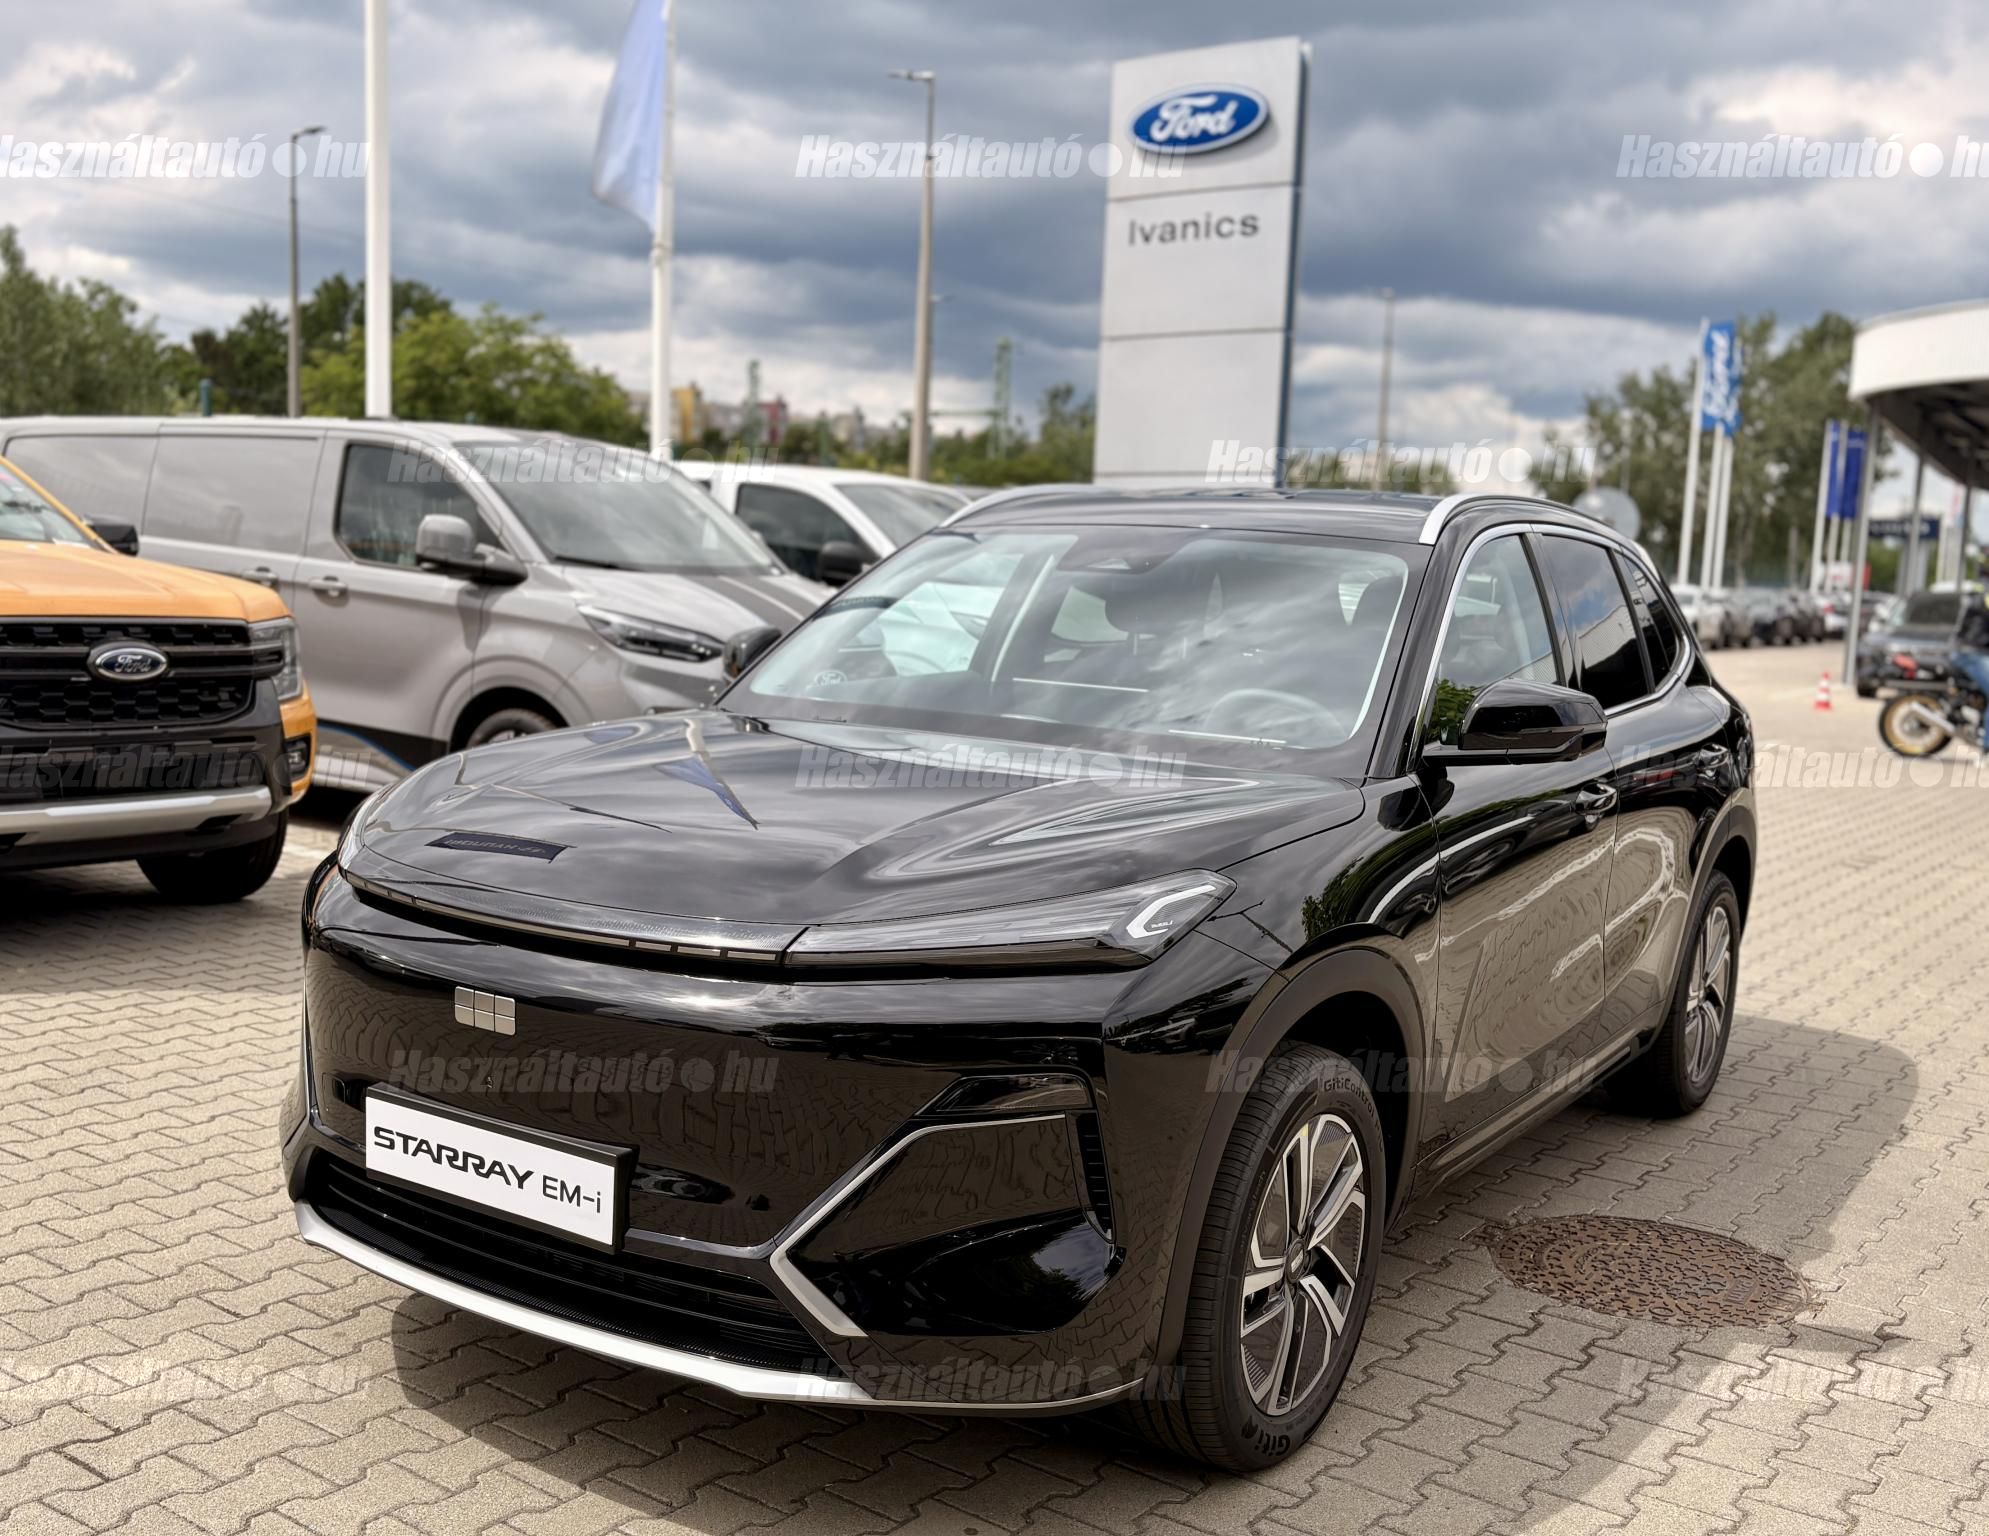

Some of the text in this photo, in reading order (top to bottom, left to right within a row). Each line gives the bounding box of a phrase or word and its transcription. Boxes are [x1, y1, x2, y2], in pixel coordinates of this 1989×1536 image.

[1150, 94, 1239, 142] Ford
[1128, 213, 1260, 247] Ivanics
[115, 654, 152, 673] Ford
[373, 1126, 602, 1214] STARRAY EM-i
[1254, 1430, 1291, 1457] Giti
